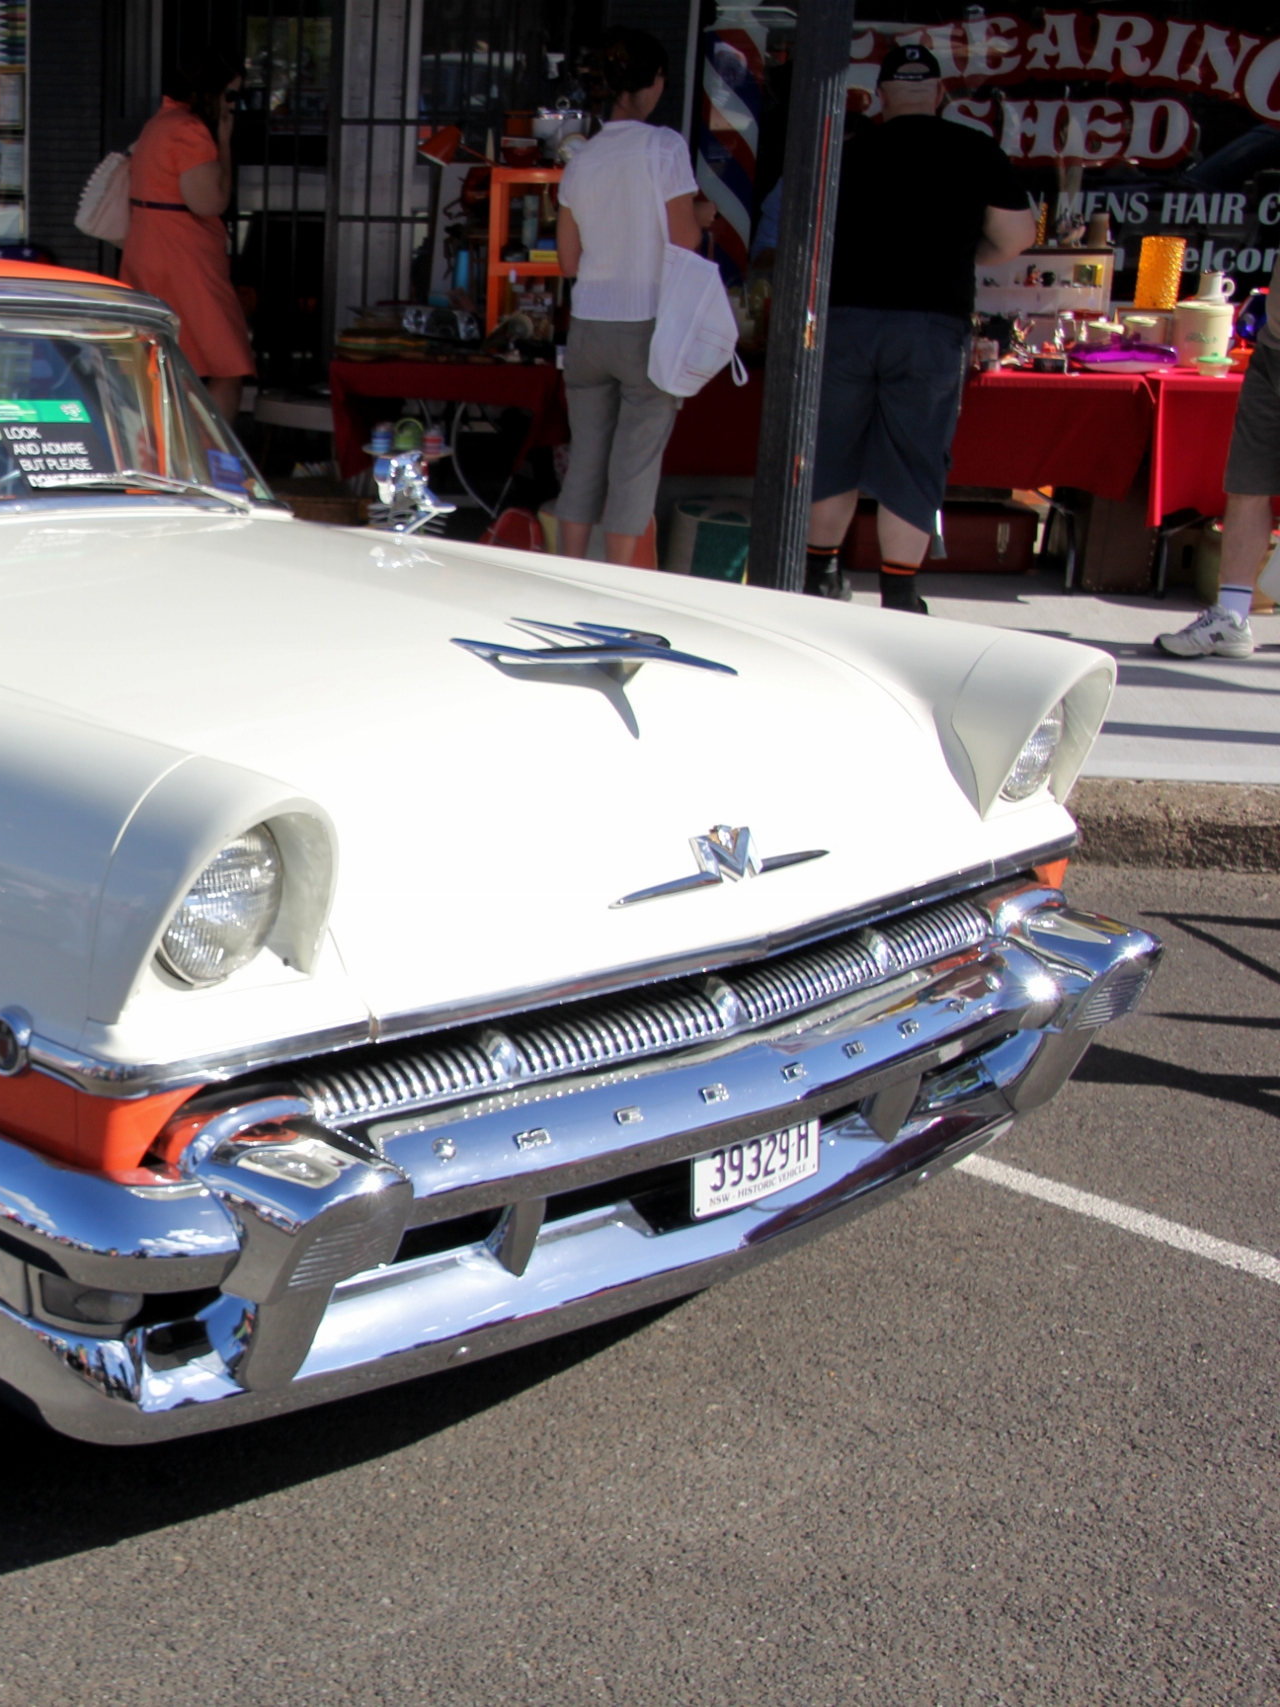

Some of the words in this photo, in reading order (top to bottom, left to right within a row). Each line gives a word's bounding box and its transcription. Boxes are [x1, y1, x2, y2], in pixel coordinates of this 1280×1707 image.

[941, 97, 1191, 160] SHED
[1056, 191, 1149, 225] MENS
[1160, 191, 1247, 225] HAIR
[3, 427, 42, 440] LOOK
[12, 442, 41, 456] AND
[41, 441, 88, 455] ADMIRE
[19, 458, 46, 471] BUT
[45, 457, 93, 471] PLEASE
[709, 1193, 731, 1208] NSW
[737, 1178, 778, 1198] HISTORIC
[778, 1163, 807, 1184] VEHICLE
